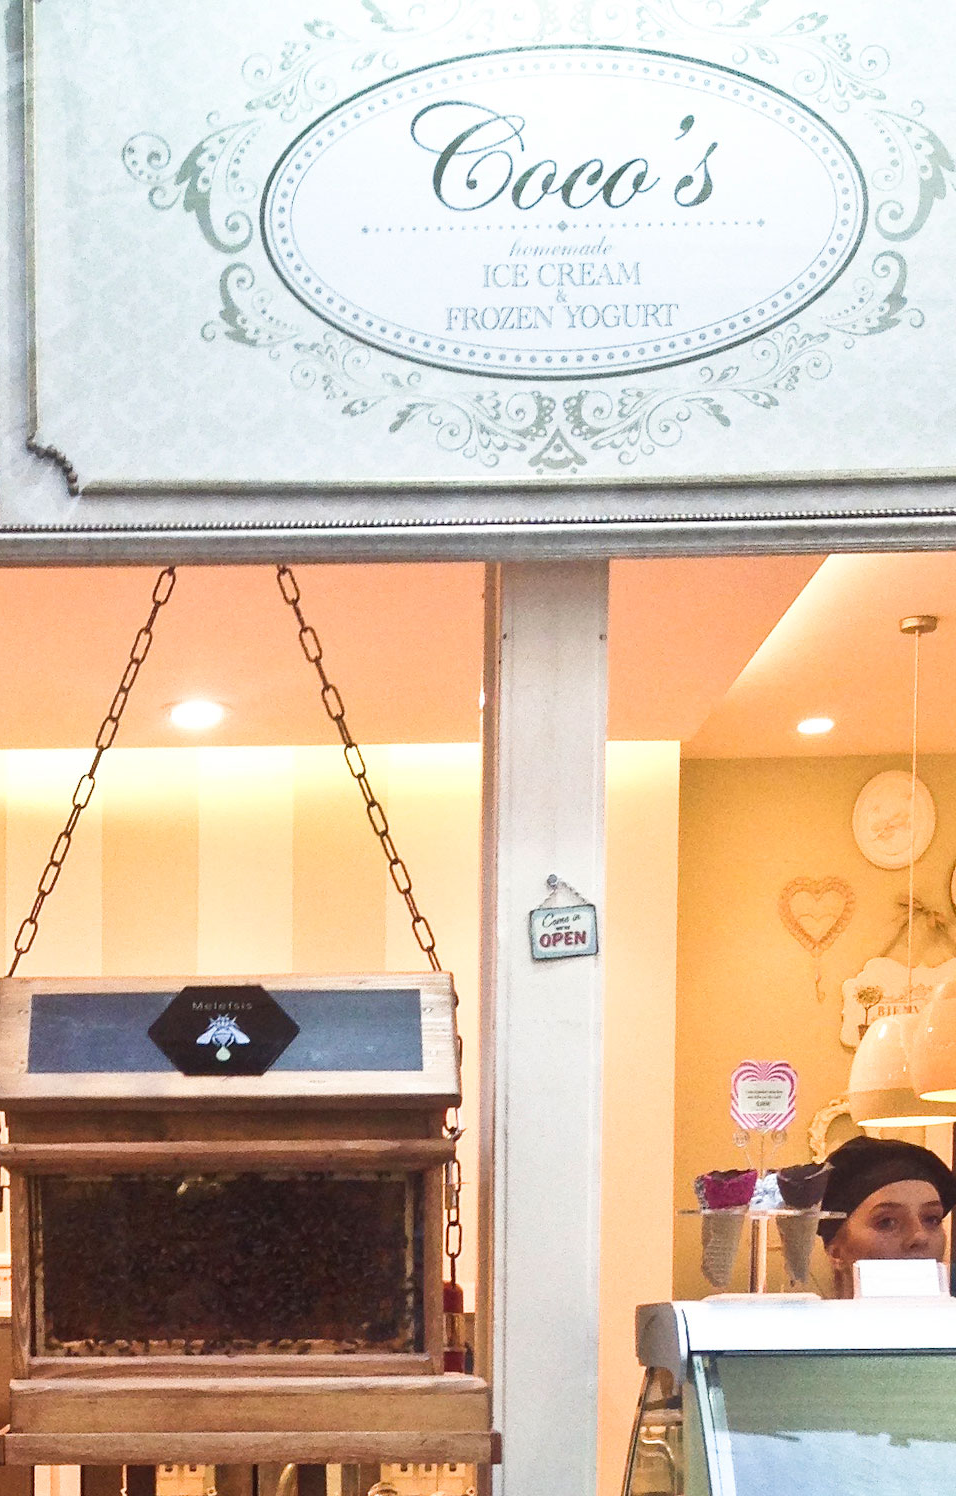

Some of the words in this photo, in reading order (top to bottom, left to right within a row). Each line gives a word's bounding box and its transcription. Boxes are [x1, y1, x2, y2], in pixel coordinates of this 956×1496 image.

[410, 100, 718, 212] Coco's
[508, 236, 613, 258] homemade
[482, 263, 529, 288] ICE
[537, 261, 641, 287] CREAM
[555, 288, 568, 303] &
[445, 305, 554, 331] FROZEN
[563, 303, 679, 330] YOGURT
[542, 912, 570, 928] Come
[539, 930, 587, 948] OPEN
